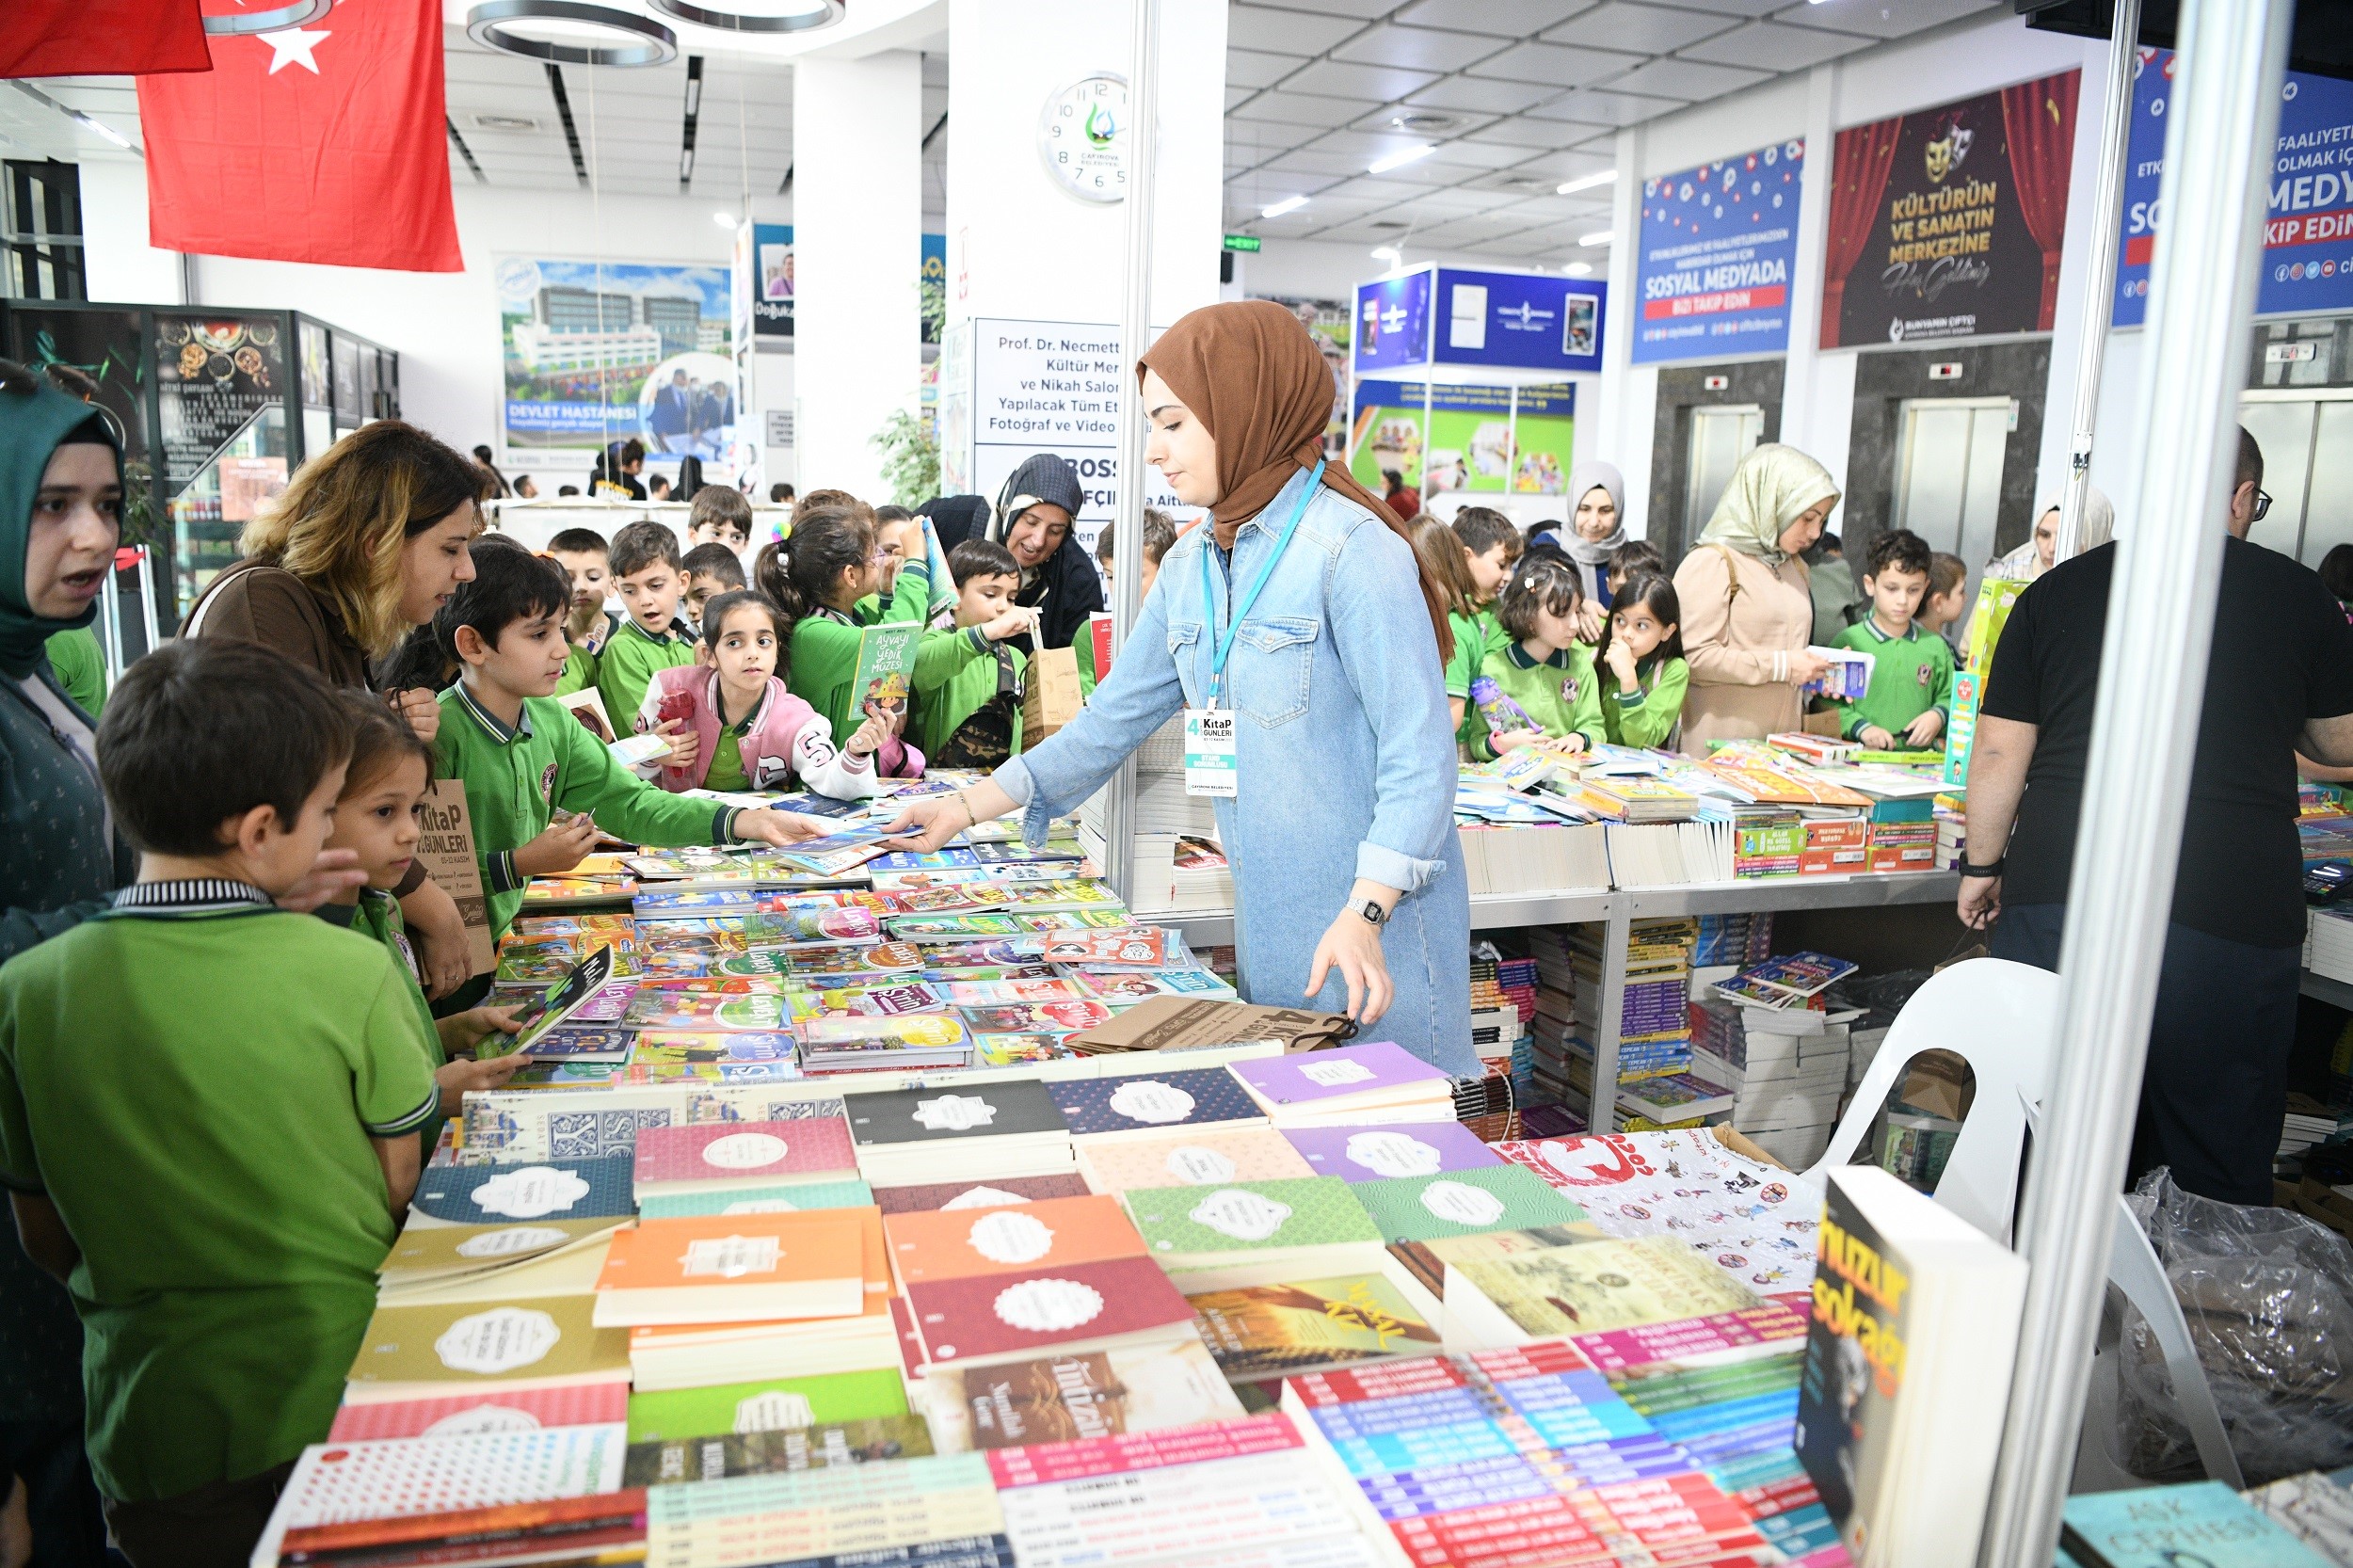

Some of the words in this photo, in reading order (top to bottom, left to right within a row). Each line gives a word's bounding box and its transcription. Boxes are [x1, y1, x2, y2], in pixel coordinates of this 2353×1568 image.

[1095, 83, 1108, 96] 12
[1059, 104, 1073, 117] 10
[1051, 125, 1062, 138] 9
[1058, 152, 1068, 164] 8
[2277, 152, 2334, 173] OLMAK
[1075, 168, 1083, 180] 7
[1095, 176, 1104, 187] 6
[2265, 169, 2353, 213] MEDY
[1891, 180, 1997, 222] KÜLTÜRÜN
[1891, 220, 1914, 242] VE
[1916, 207, 1995, 238] SANATIN
[2263, 219, 2301, 247] KİP
[1889, 229, 1992, 265] MERKEZİNE
[1644, 270, 1703, 300] SOSYAL
[1703, 257, 1787, 292] MEDYADA
[999, 336, 1032, 350] Prof.
[1036, 338, 1056, 351] Dr.
[1061, 340, 1120, 354] Necmett
[1047, 359, 1090, 373] Kültür
[1020, 379, 1036, 391] ve
[1040, 378, 1081, 392] Nikah
[1085, 380, 1119, 393] Salo
[509, 405, 560, 418] DEVLET
[999, 397, 1065, 413] Yapılacak
[1071, 399, 1100, 412] Tüm
[989, 417, 1050, 433] Fotoğraf
[1055, 421, 1071, 431] ve
[1076, 420, 1115, 433] Video
[875, 633, 910, 650] AYVAYI
[871, 660, 904, 674] MÜZESİ
[1187, 718, 1200, 736] 4
